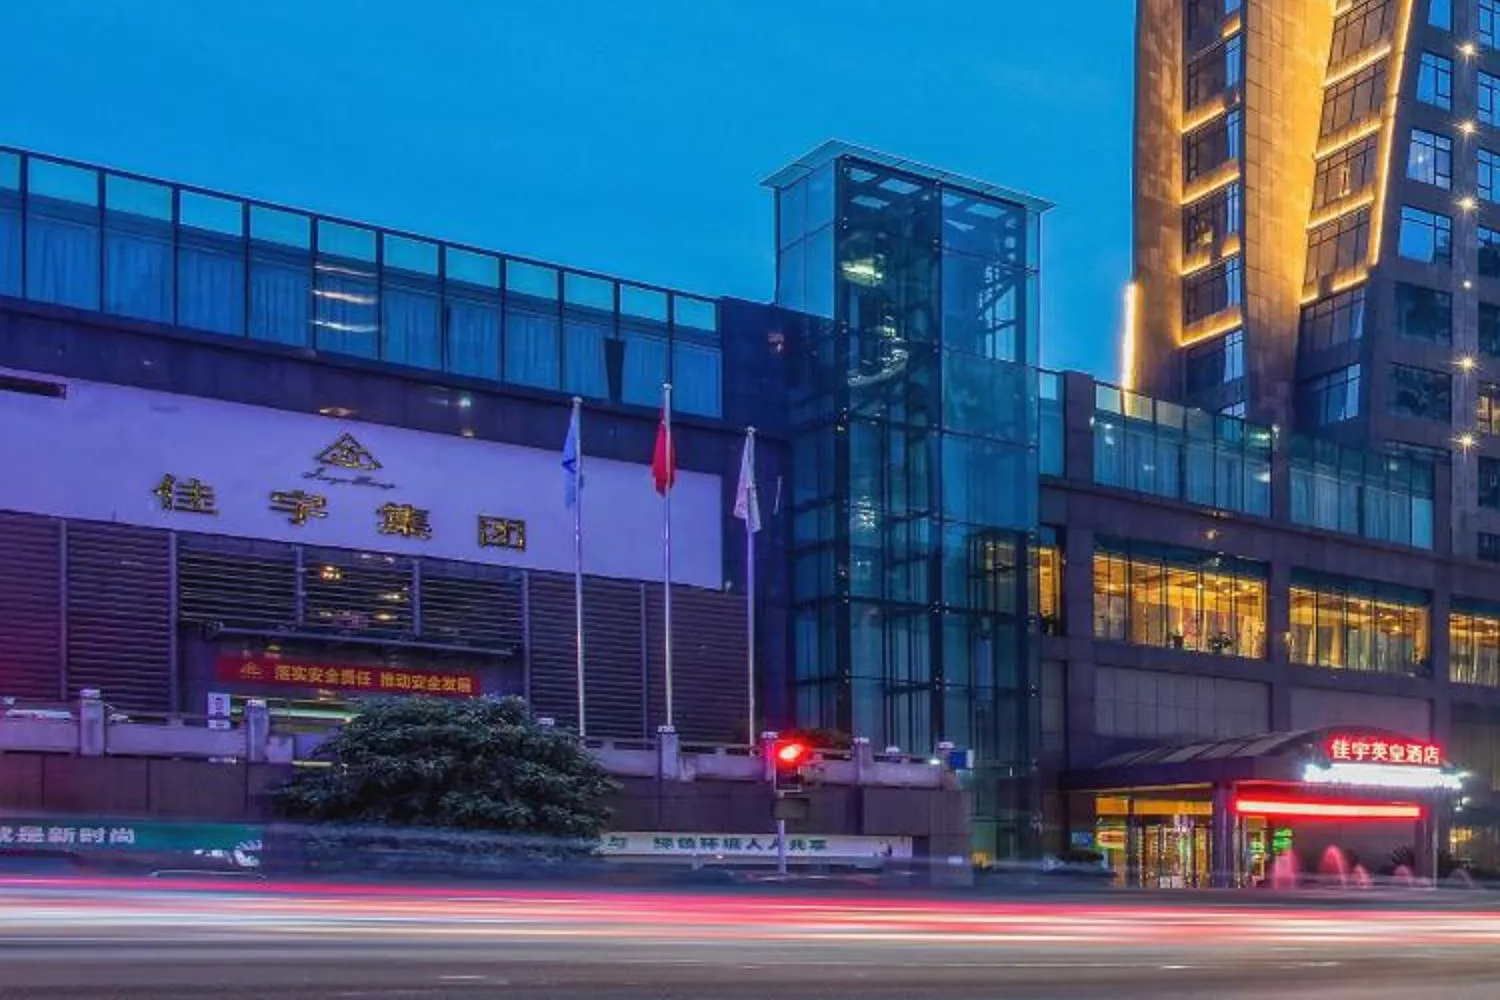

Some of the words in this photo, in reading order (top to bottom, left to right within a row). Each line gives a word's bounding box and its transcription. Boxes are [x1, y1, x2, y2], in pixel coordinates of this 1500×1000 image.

[1331, 738, 1440, 765] 佳宇英皇酒店
